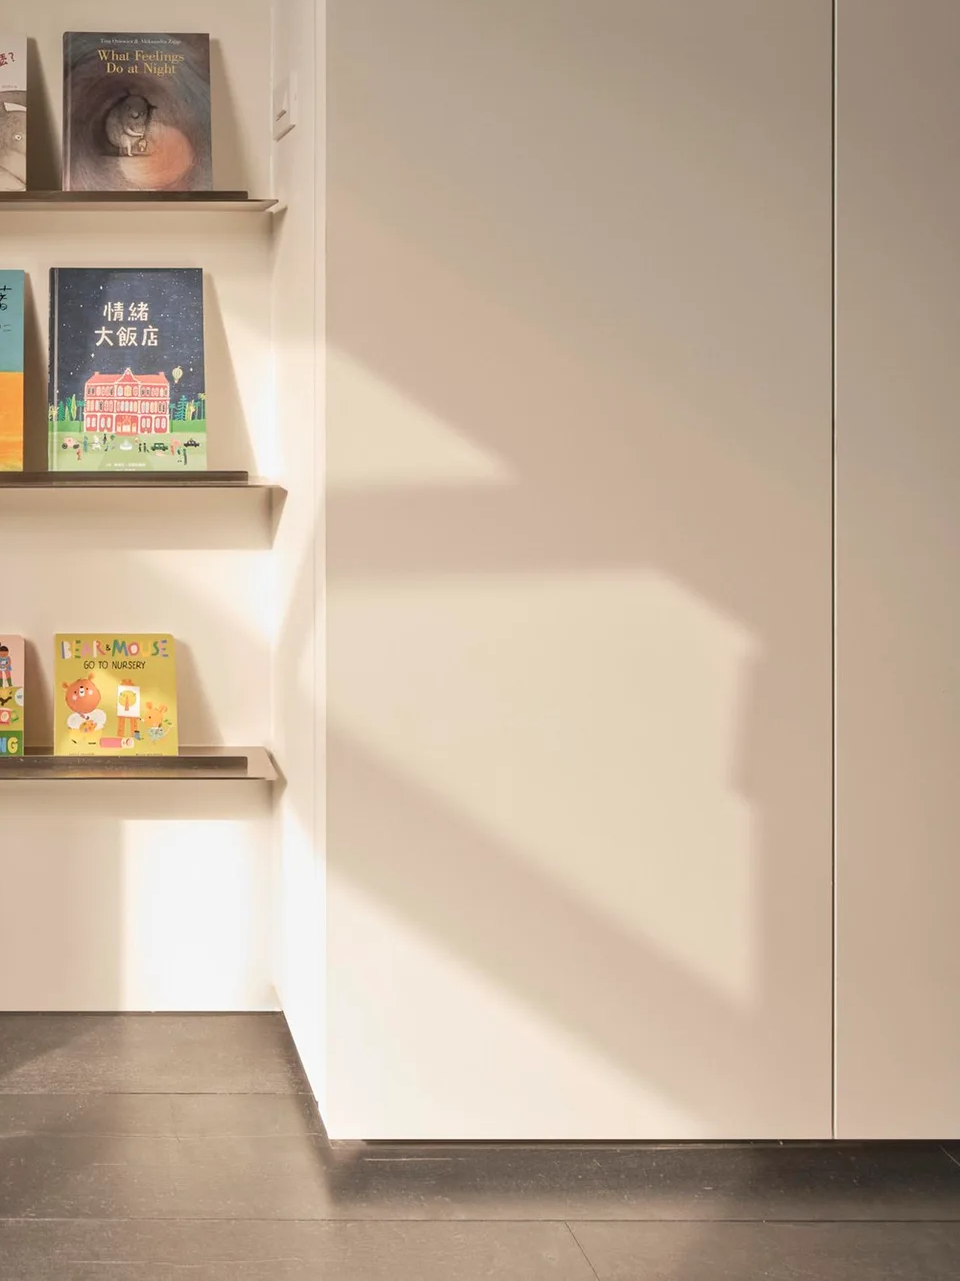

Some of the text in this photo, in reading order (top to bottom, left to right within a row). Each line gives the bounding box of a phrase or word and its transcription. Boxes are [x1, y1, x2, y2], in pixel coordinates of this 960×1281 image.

[98, 50, 185, 63] What Feelings
[106, 63, 176, 76] Do at Night
[103, 301, 149, 322] 情緒
[94, 325, 159, 347] 大飯店
[61, 639, 106, 659] BEAR
[112, 639, 169, 658] MOUSE
[83, 660, 146, 669] GO TO NURSERY
